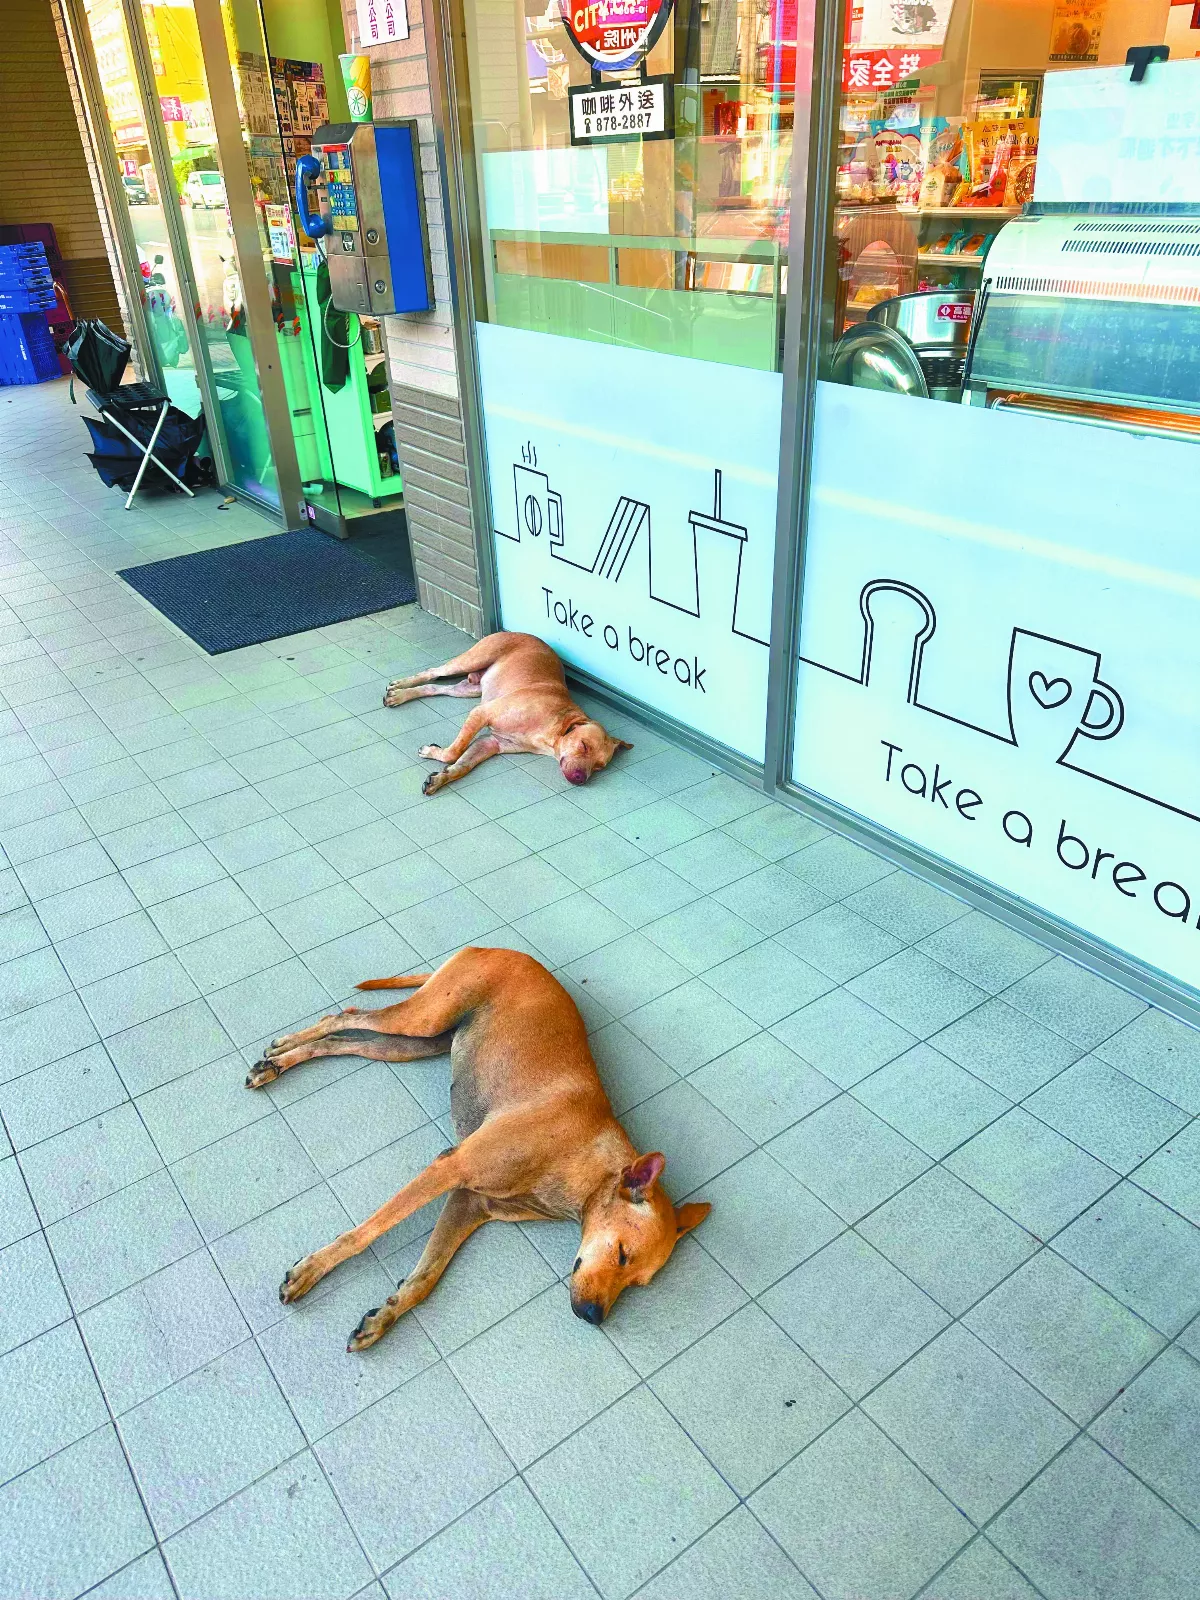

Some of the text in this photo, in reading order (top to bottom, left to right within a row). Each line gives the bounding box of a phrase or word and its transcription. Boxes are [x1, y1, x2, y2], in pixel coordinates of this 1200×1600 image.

[581, 89, 655, 116] 咖啡外送
[596, 112, 652, 132] 878-2887
[541, 586, 707, 694] Take a break
[880, 739, 1200, 930] Take a brea
